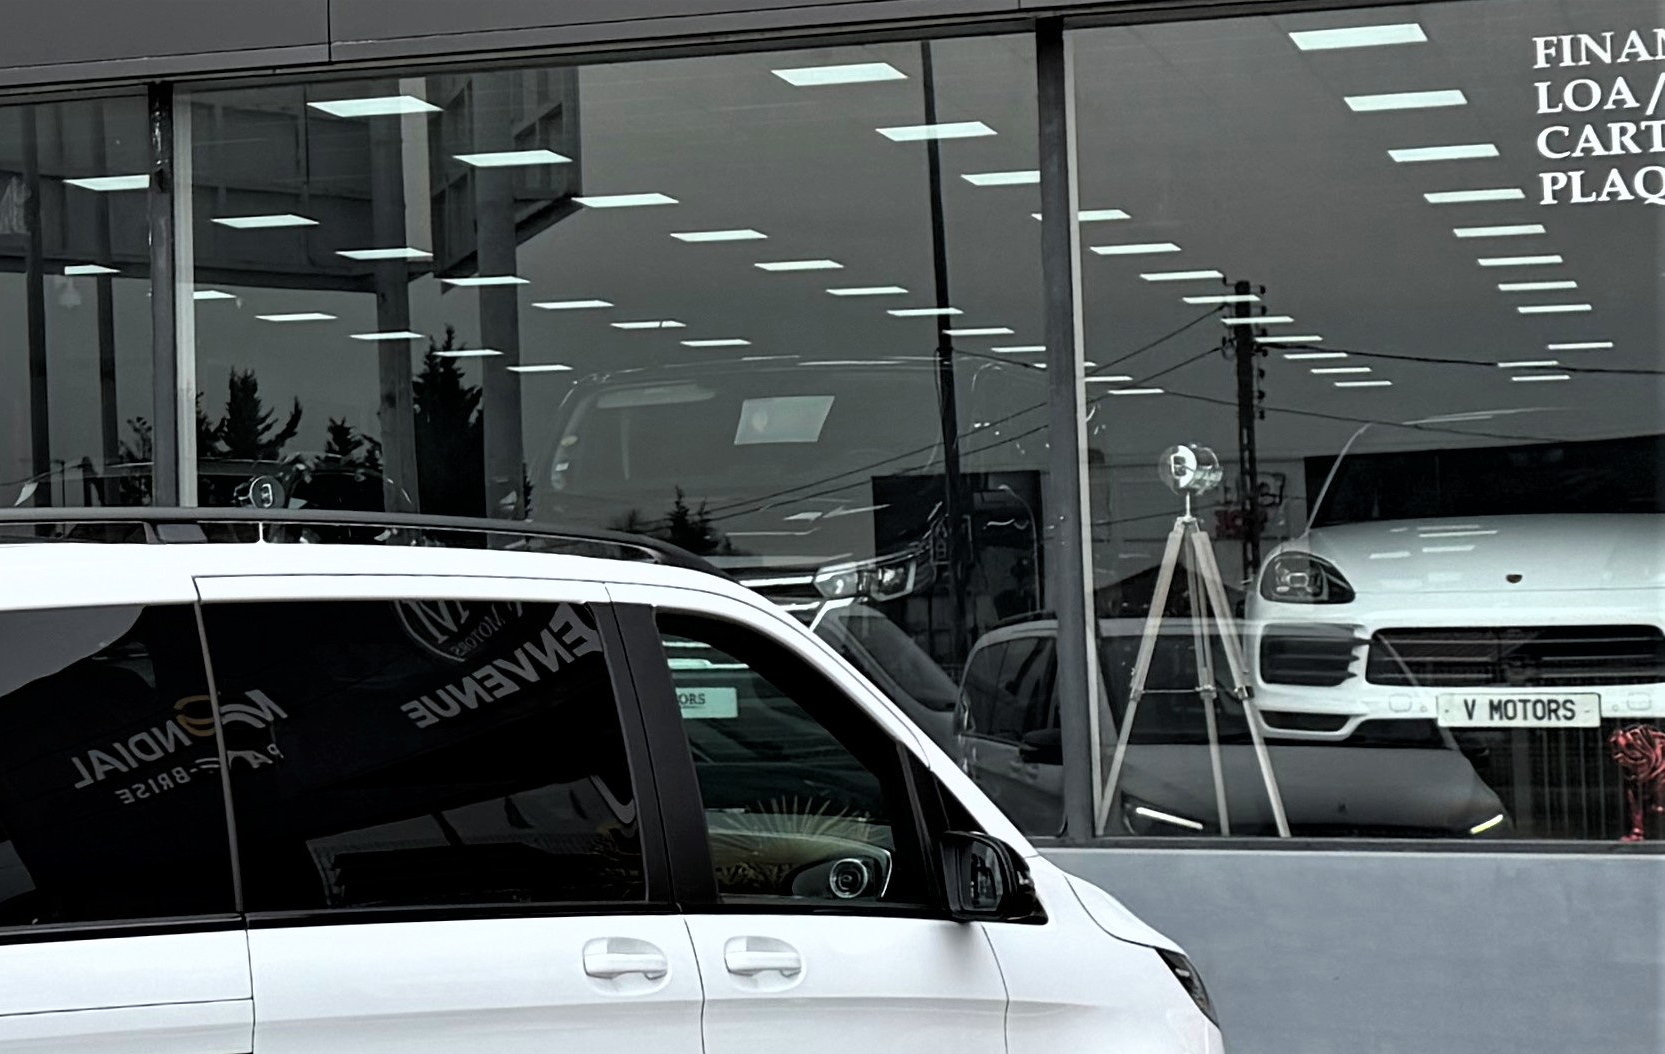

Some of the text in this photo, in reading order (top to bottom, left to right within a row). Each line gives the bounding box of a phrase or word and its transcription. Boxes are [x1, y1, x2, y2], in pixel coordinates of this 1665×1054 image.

[1537, 120, 1665, 159] CART
[1539, 165, 1665, 205] PLAQ
[1463, 698, 1576, 721] V MOTORS
